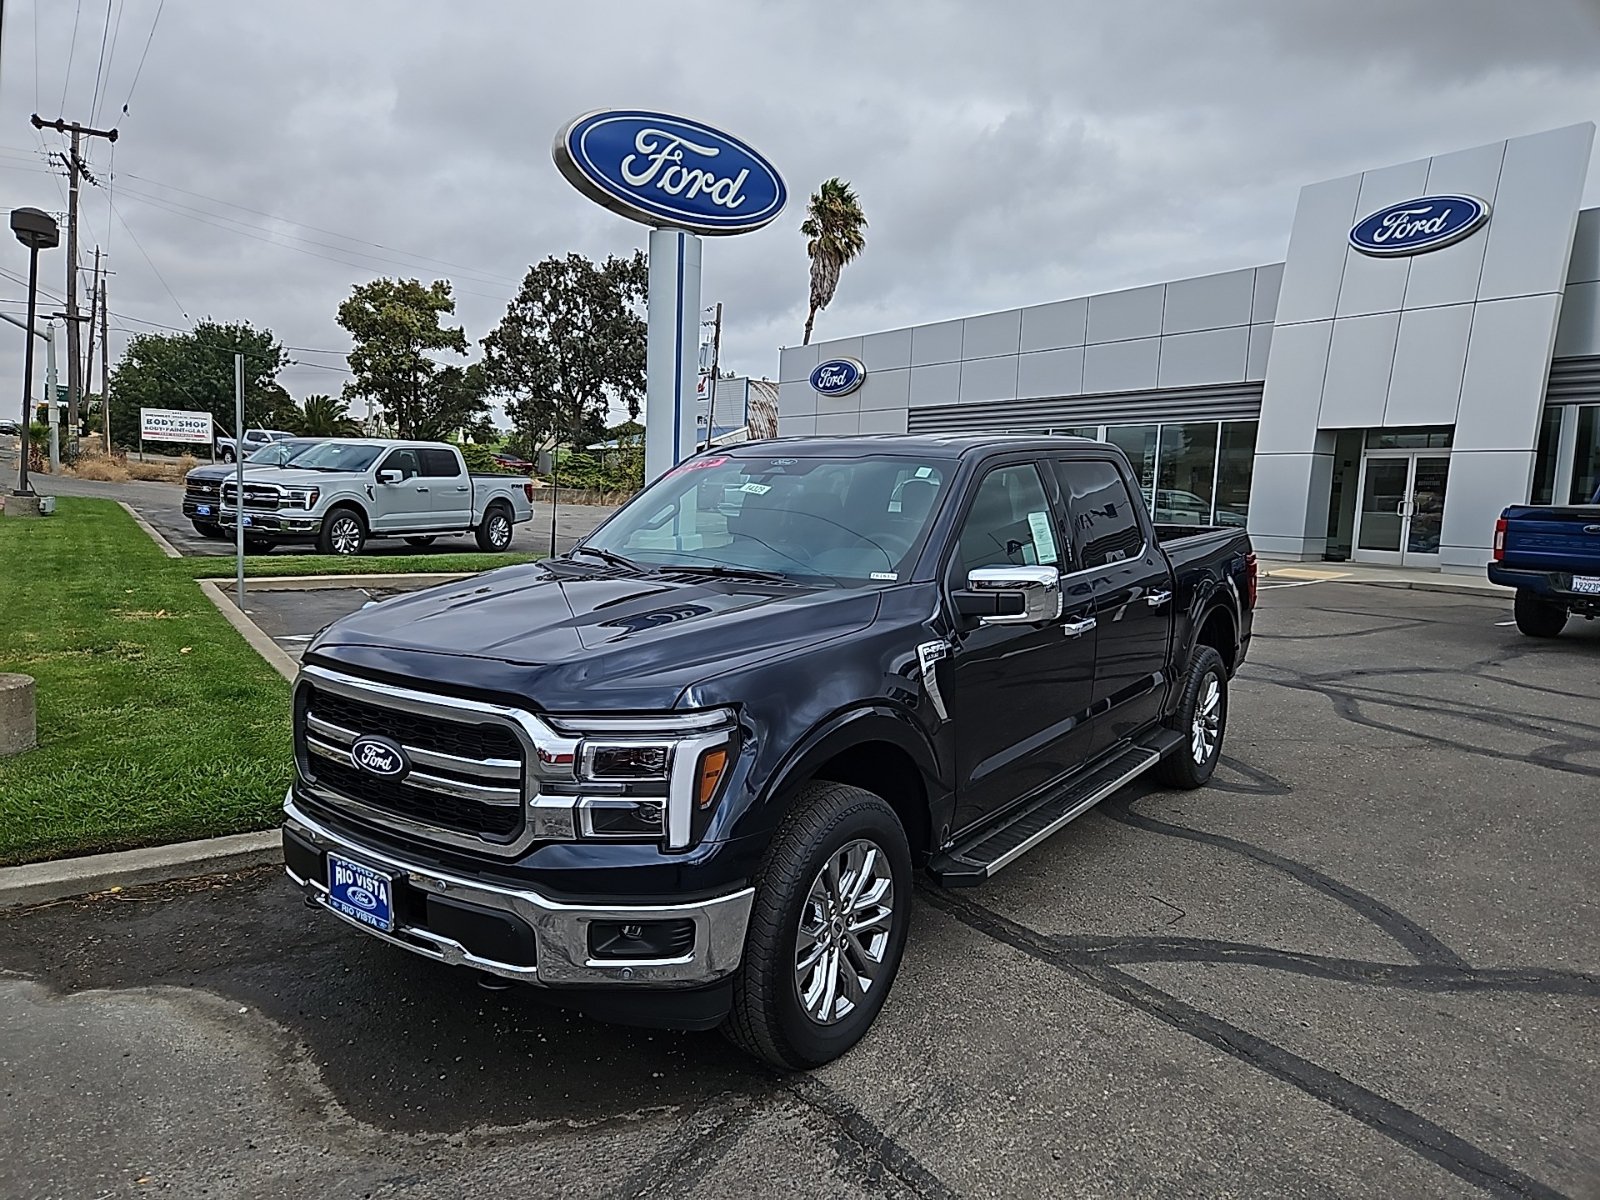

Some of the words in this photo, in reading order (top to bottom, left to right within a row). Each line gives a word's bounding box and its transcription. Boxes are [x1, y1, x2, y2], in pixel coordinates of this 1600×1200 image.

[621, 128, 750, 208] Ford
[1373, 206, 1452, 243] Ford
[818, 366, 848, 388] Ford
[146, 418, 175, 426] BODY
[178, 420, 208, 428] SHOP
[361, 744, 393, 770] Ford
[335, 865, 354, 886] RIO
[355, 872, 388, 907] VISTA
[354, 890, 369, 904] Ford
[341, 904, 355, 916] RIO
[355, 909, 378, 926] VISTA
